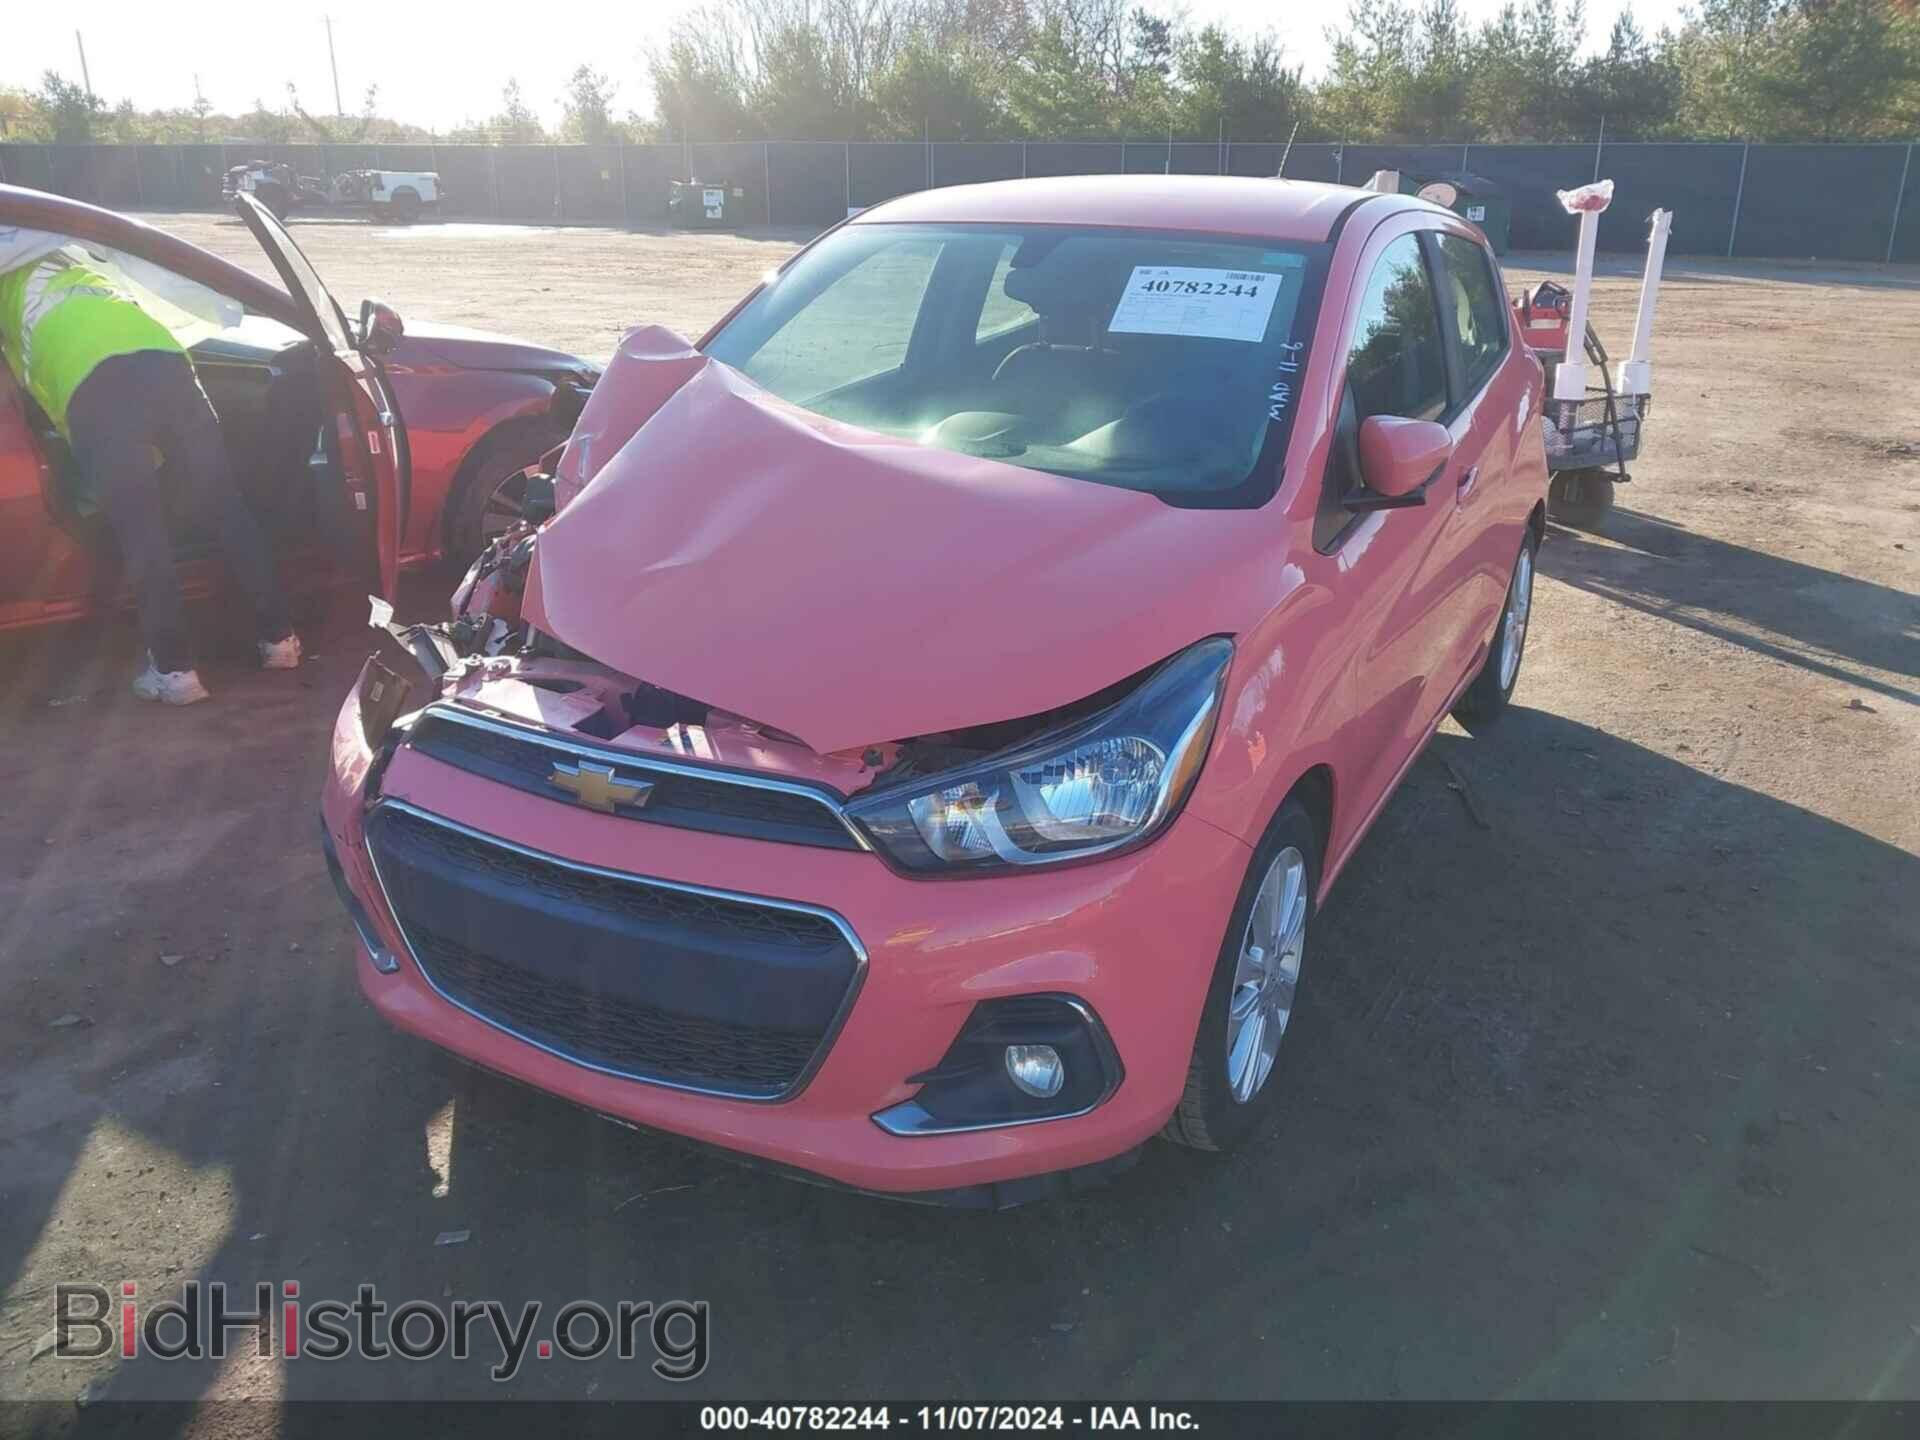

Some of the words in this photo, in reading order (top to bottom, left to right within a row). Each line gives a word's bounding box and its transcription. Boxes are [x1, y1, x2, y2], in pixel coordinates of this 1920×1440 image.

[1141, 279, 1258, 298] 40782244
[1279, 342, 1304, 372] 11-6
[1268, 381, 1291, 421] MAD
